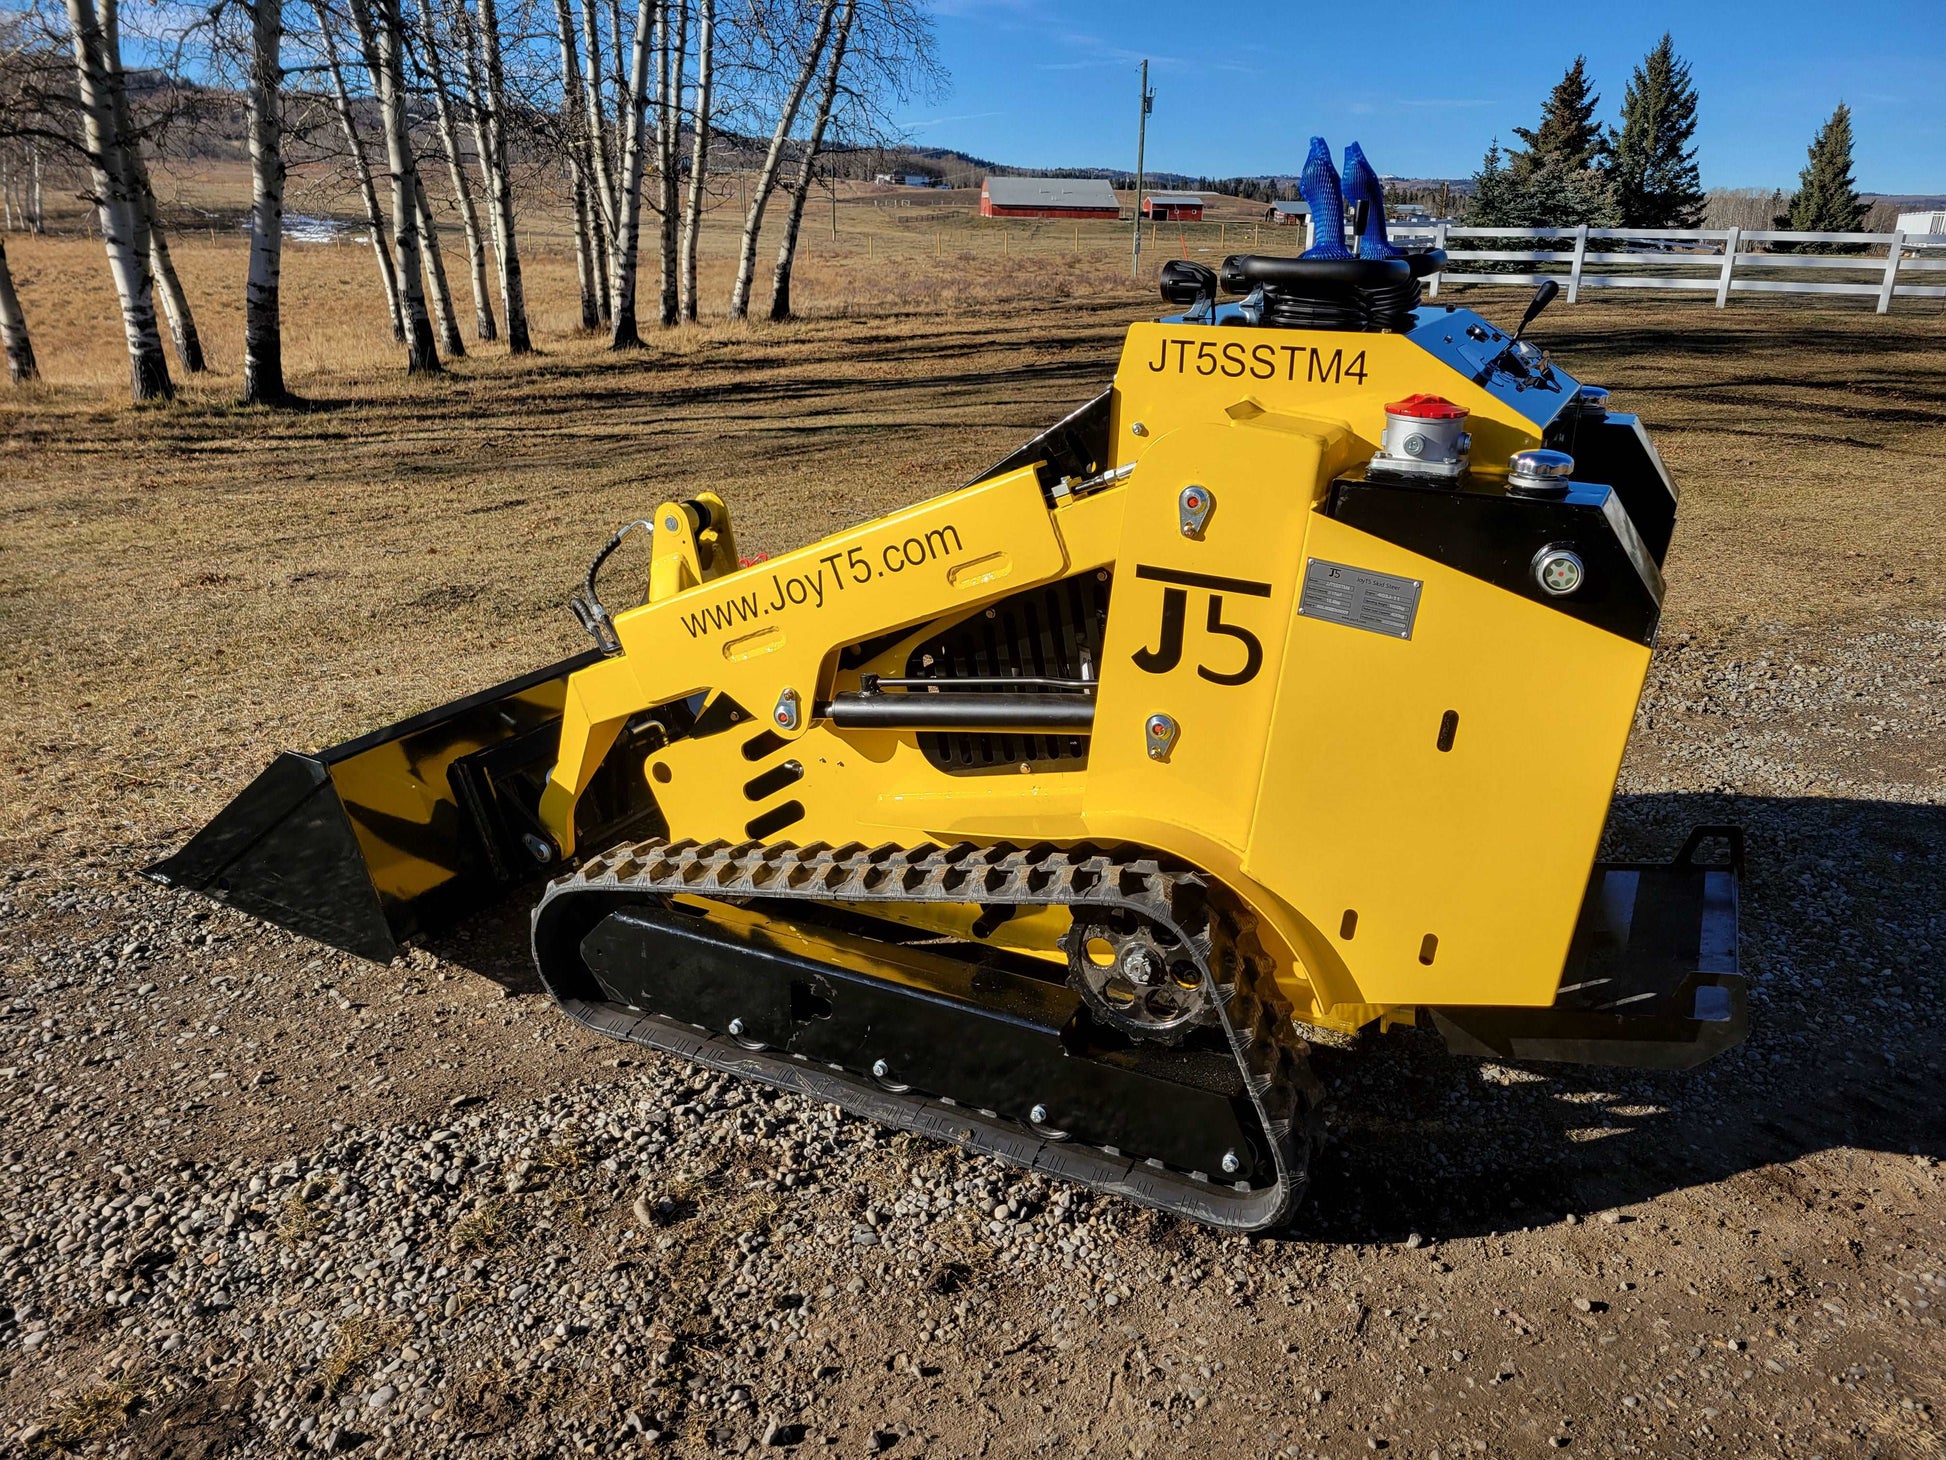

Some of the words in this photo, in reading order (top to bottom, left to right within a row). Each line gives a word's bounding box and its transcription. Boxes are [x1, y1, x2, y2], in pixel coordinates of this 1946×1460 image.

[1148, 338, 1369, 386] JT5SSTM4
[680, 523, 964, 639] www.JoyT5.com
[1328, 567, 1342, 579] J5
[1372, 579, 1385, 588] Skid
[1386, 582, 1401, 591] Steer
[1130, 564, 1272, 687] J5
